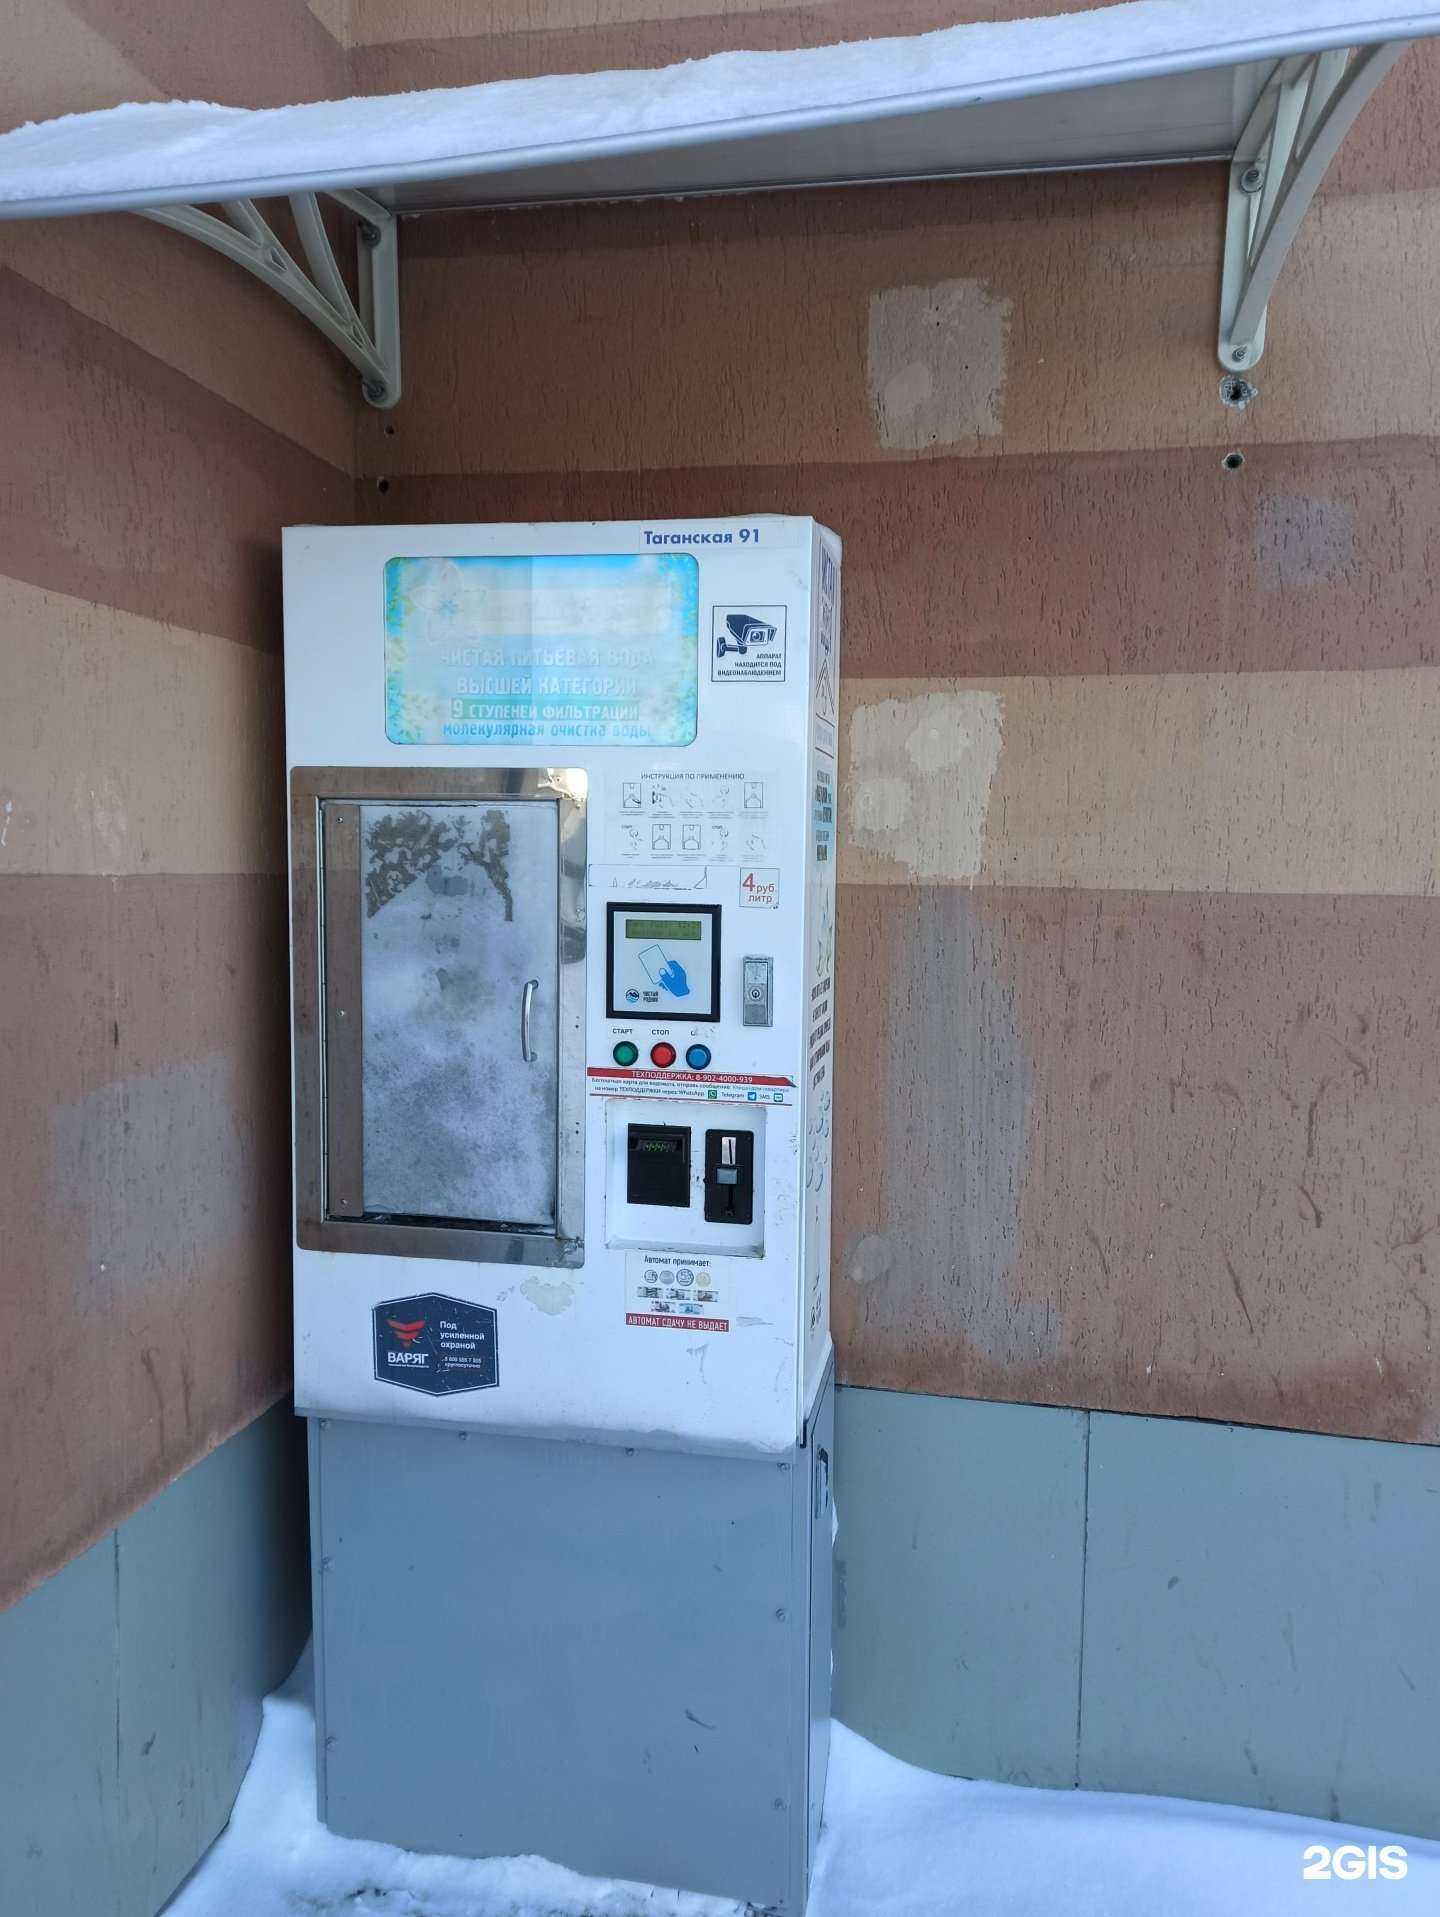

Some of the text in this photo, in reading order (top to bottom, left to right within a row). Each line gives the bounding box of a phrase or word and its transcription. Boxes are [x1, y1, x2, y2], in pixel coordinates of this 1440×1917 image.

[644, 528, 760, 545] Таганская 91
[441, 650, 505, 667] ЧИСТАЯ
[769, 661, 782, 669] ПОД
[456, 674, 638, 697] ВЫСШЕЙ КАТЕГОРИИ
[452, 700, 640, 721] 9 СТУПЕНЕЙ ФИЛЬТРАЦИИ
[641, 772, 745, 780] ИНСТРУКЦИЯ ПО ПРИМЕНЕНИЮ
[742, 872, 775, 895] 4 руб
[748, 894, 773, 904] литр
[612, 1027, 633, 1035] СТАРТ
[631, 1070, 753, 1083] ТЕХПОДДЕРЖКА: 8-902-4000-939
[644, 1255, 671, 1265] Автомат
[440, 1320, 457, 1330] Под
[628, 1316, 728, 1332] АВТОМАТ СДАЧУ НЕ ВЫДАЕТ
[440, 1331, 485, 1341] усиленной
[440, 1342, 476, 1350] охраной
[387, 1351, 429, 1365] ВАРЯГ
